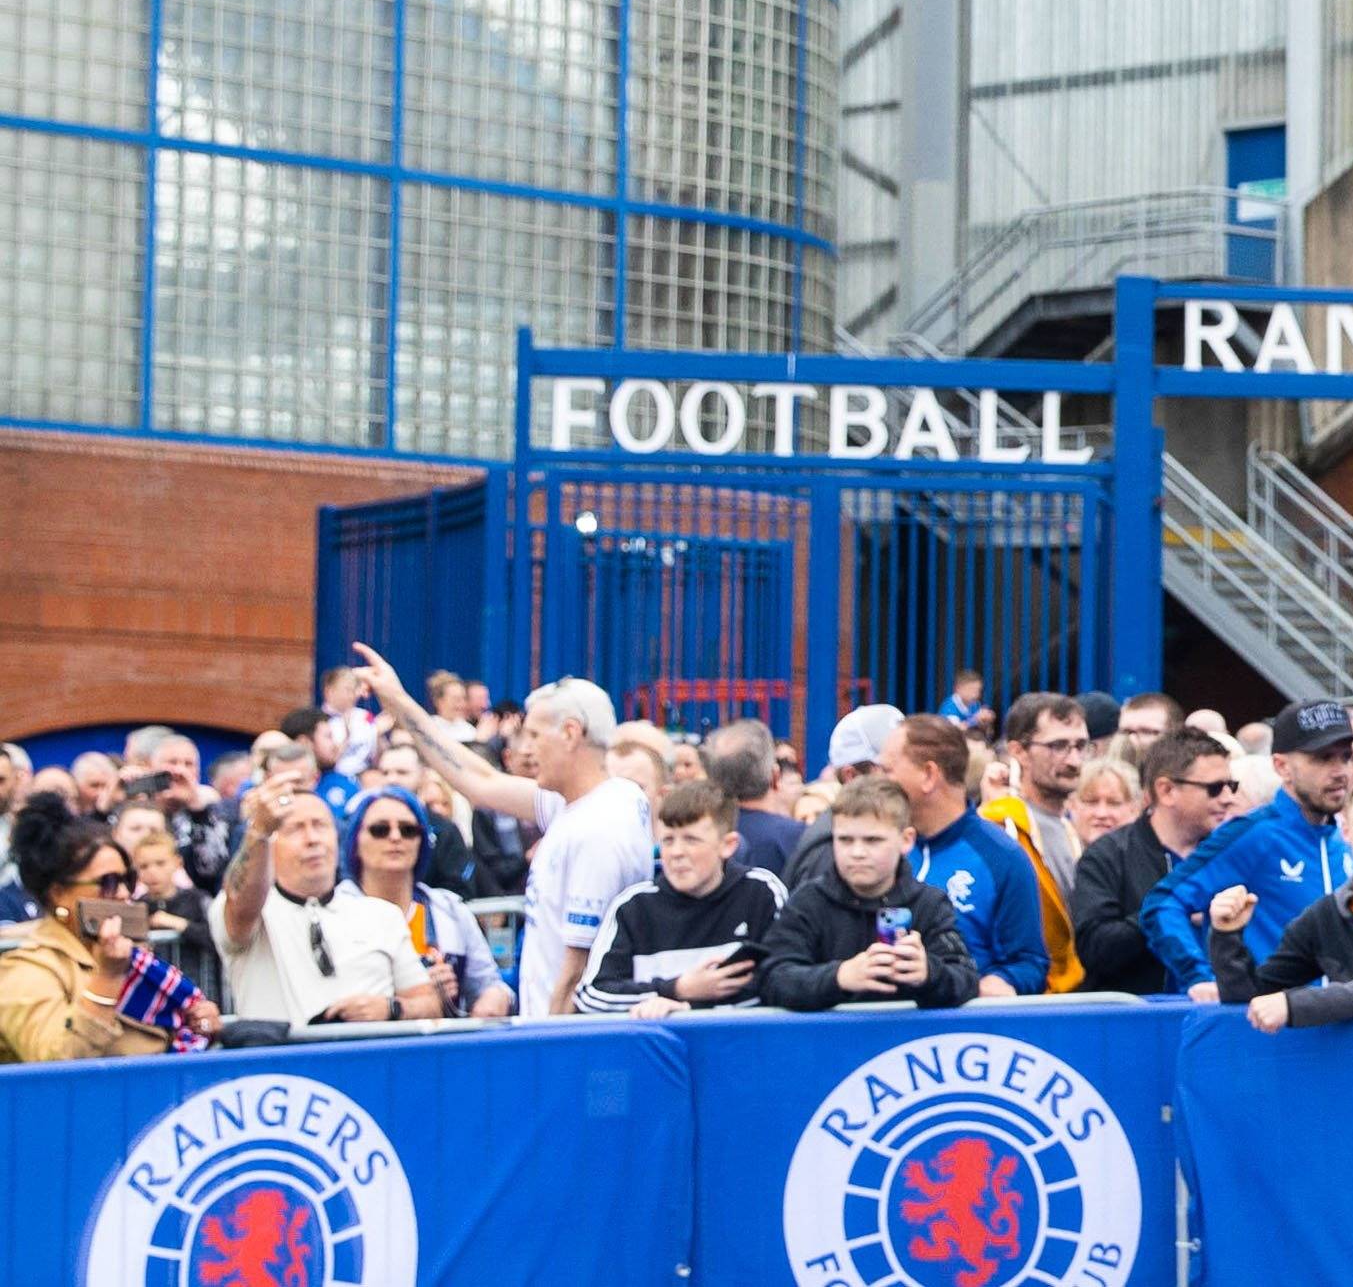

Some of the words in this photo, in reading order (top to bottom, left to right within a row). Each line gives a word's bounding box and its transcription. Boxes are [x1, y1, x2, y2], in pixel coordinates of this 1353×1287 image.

[551, 377, 1094, 466] FOOTBALL
[127, 1085, 390, 1204] RANGERS
[820, 1043, 1106, 1147] RANGERS
